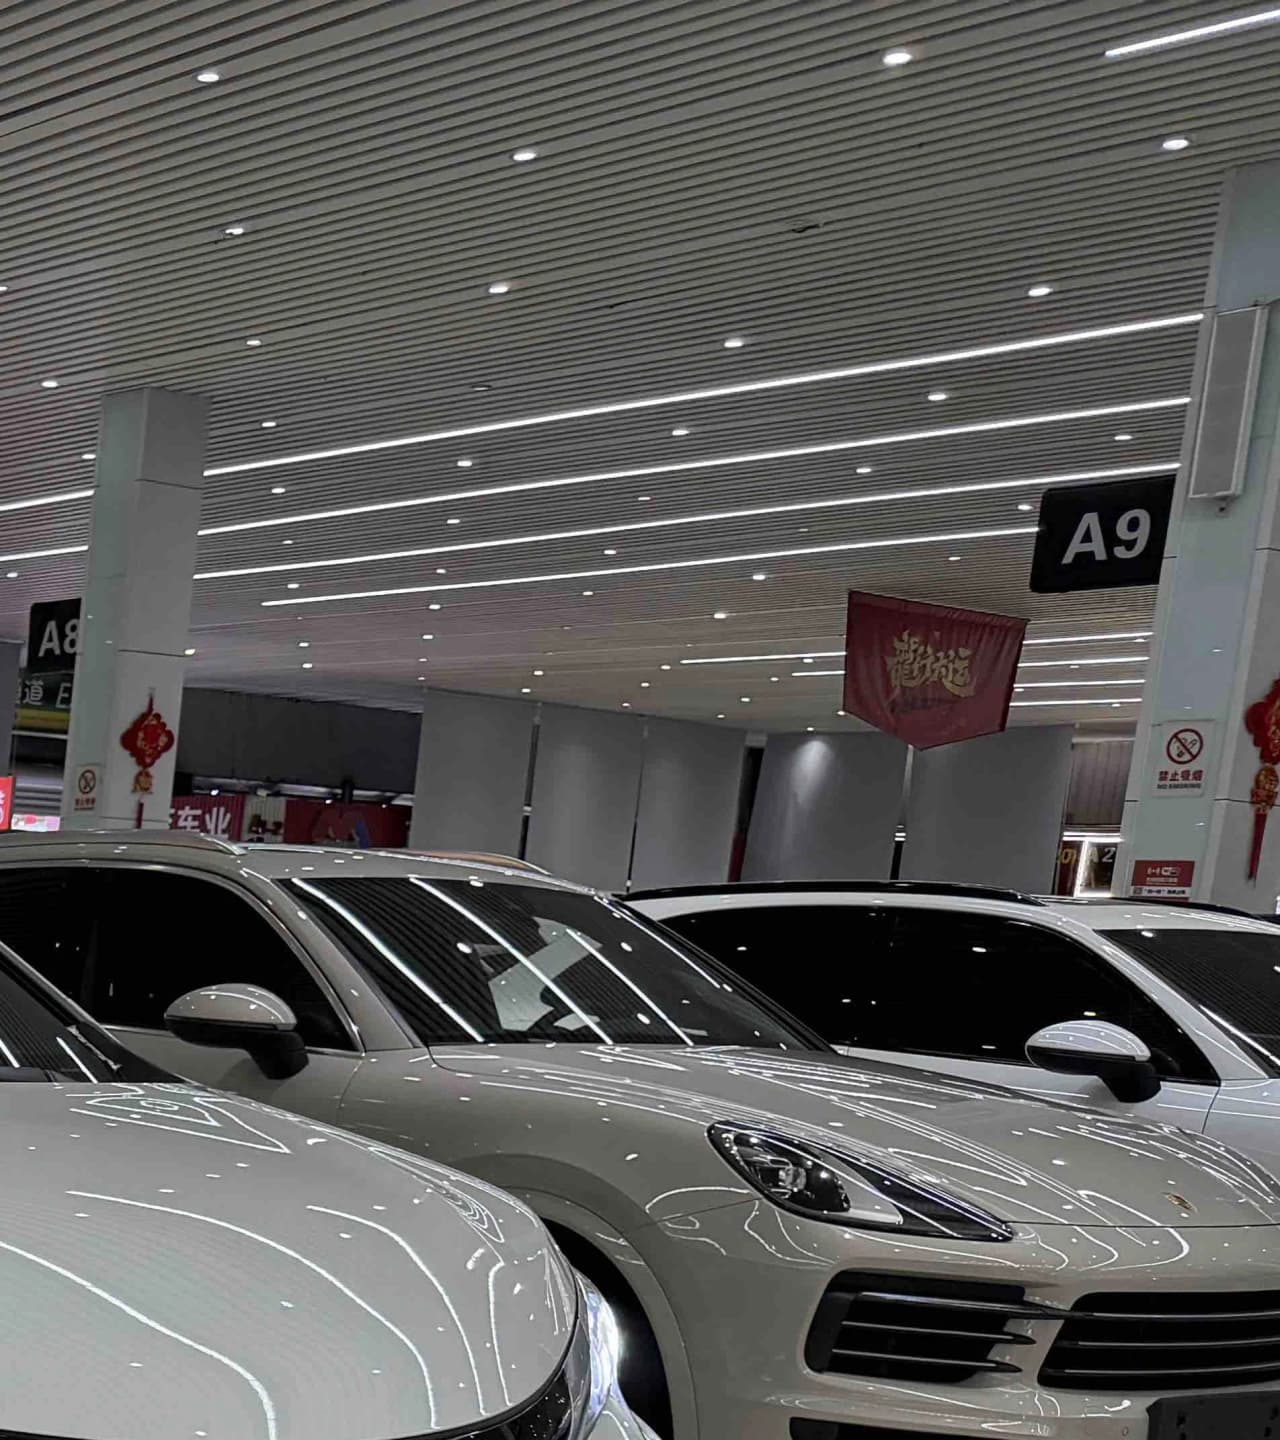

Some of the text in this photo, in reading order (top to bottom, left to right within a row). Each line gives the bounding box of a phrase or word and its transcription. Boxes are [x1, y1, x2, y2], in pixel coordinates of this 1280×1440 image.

[1061, 509, 1151, 564] A9
[38, 618, 80, 657] A8
[17, 678, 44, 706] 道
[170, 805, 231, 836] 车业
